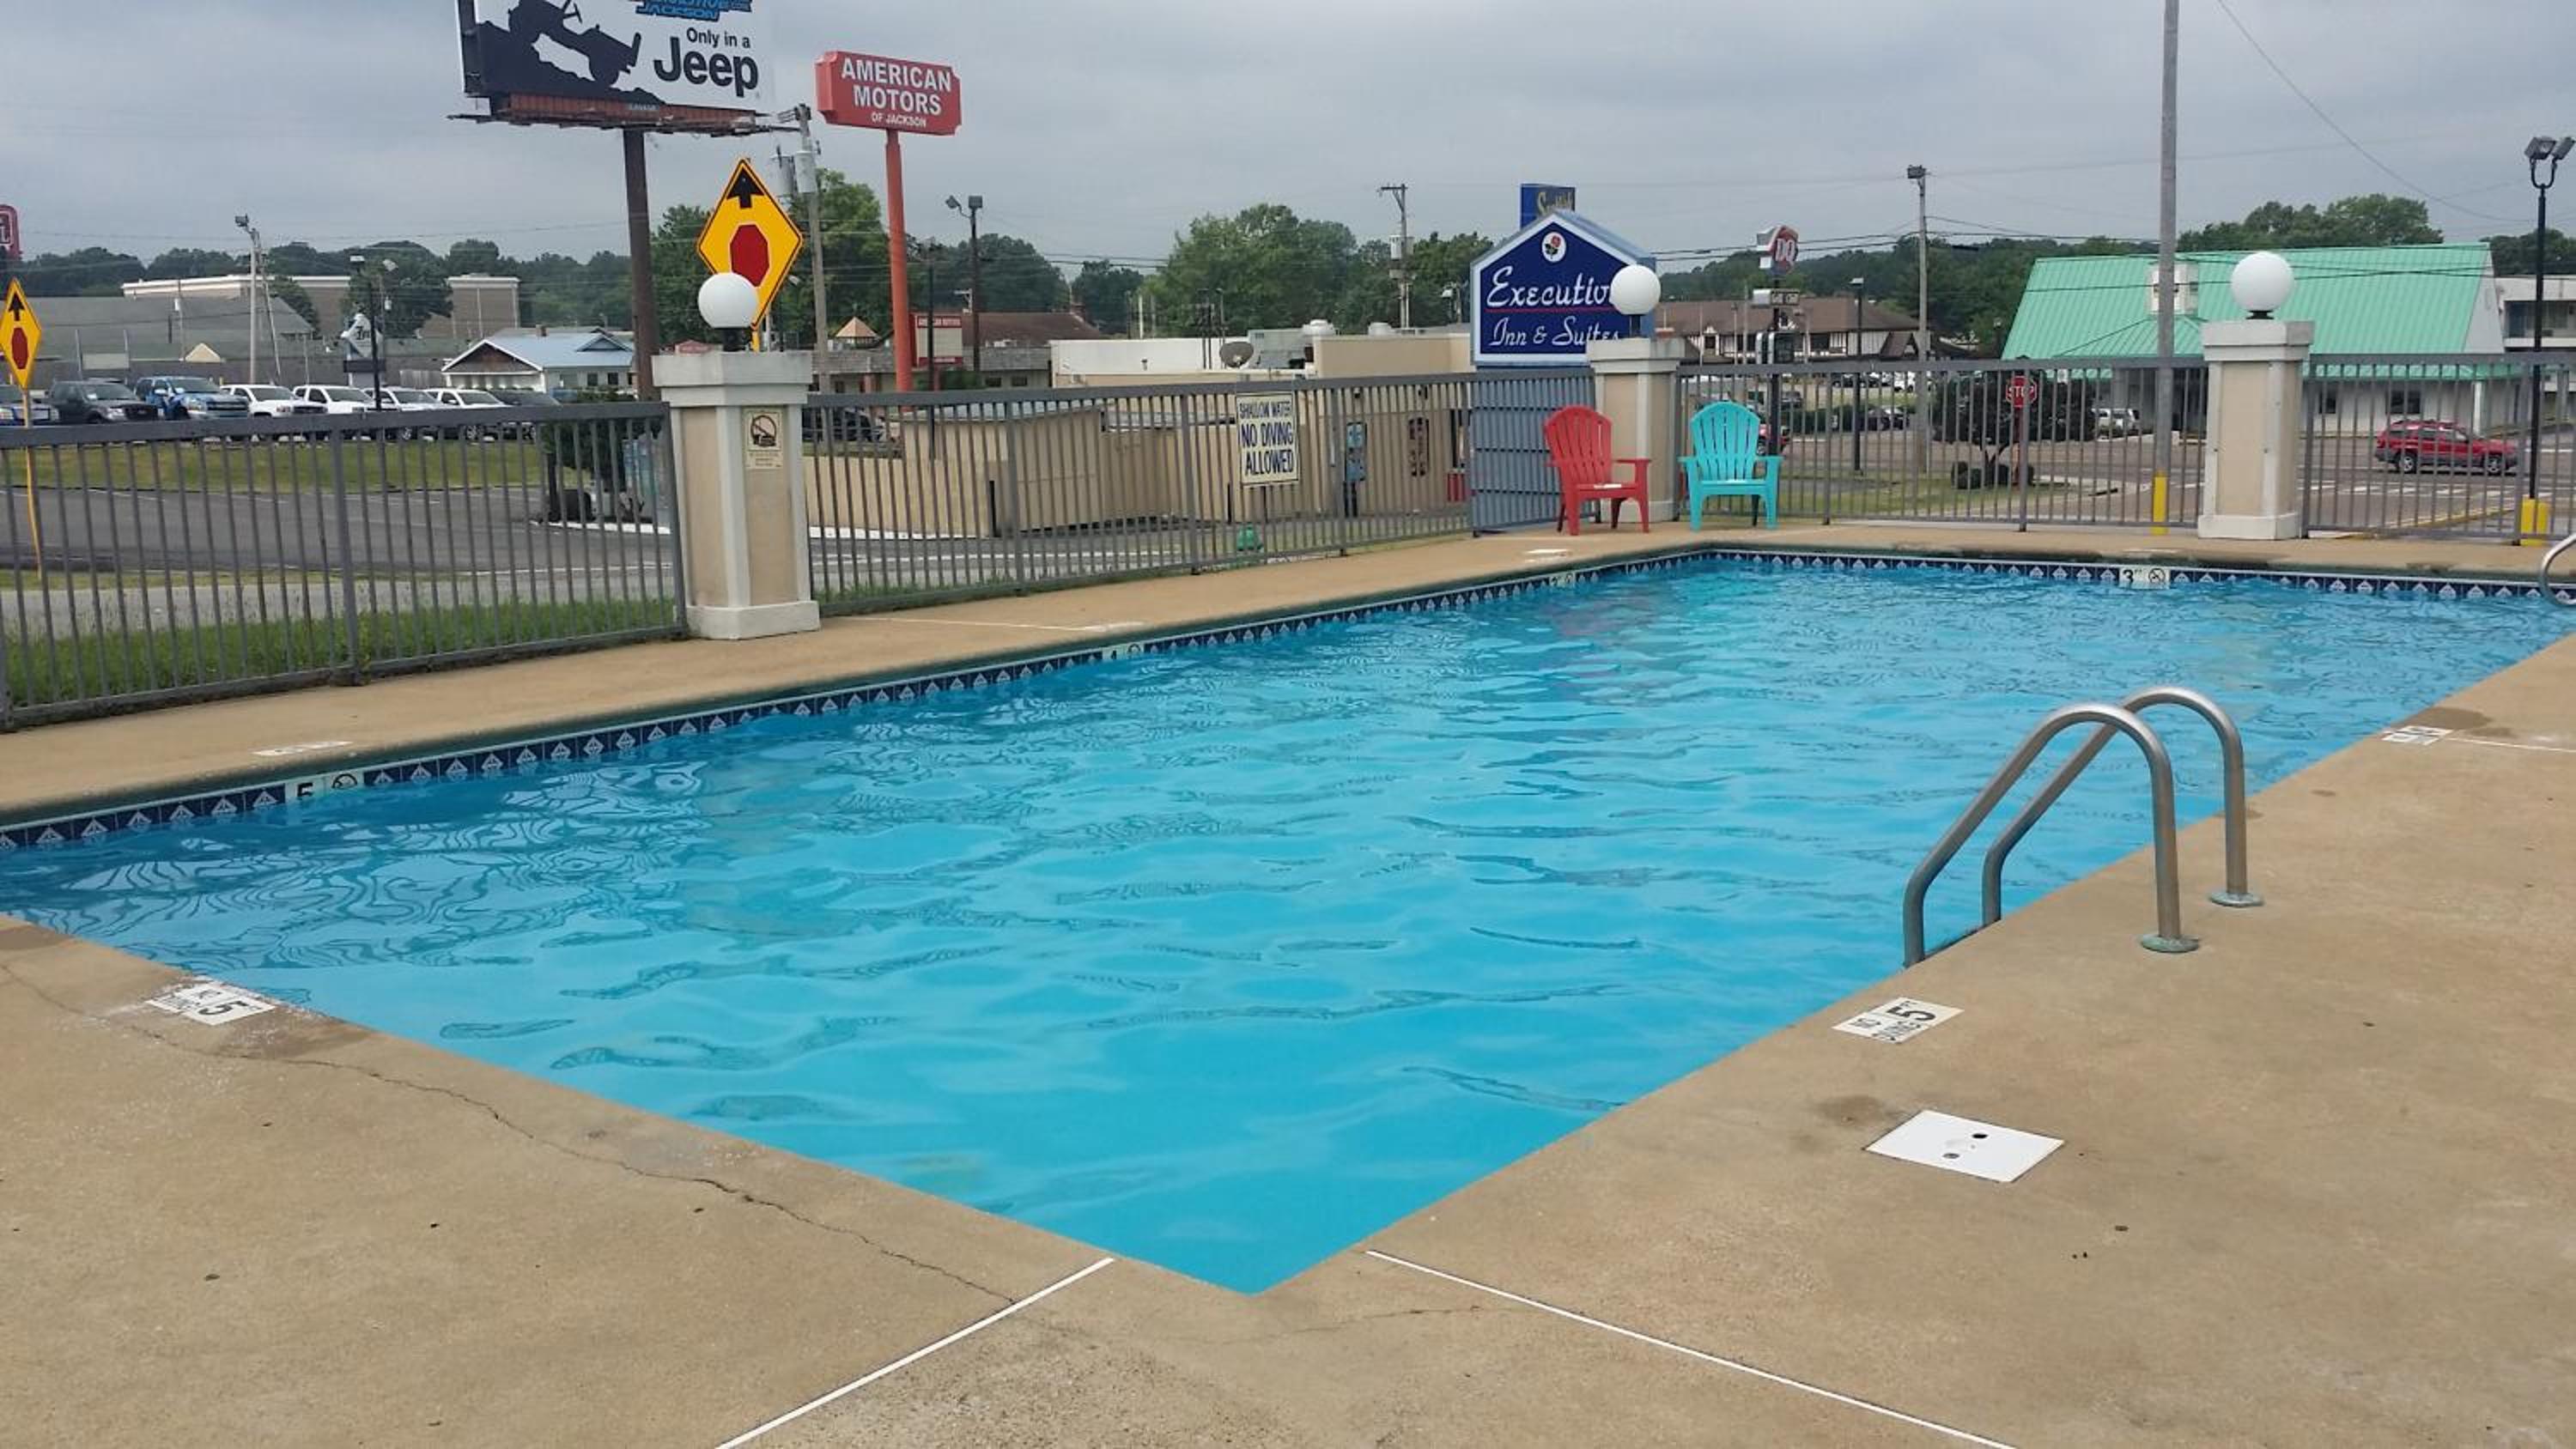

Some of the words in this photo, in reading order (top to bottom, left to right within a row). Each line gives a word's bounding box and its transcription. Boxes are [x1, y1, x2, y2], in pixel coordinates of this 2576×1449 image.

[686, 27, 720, 48] Only
[724, 31, 738, 47] in
[742, 37, 750, 48] a
[653, 36, 758, 98] Jeep
[841, 58, 951, 92] AMERICAN
[854, 85, 942, 116] MOTORS
[871, 112, 883, 122] OF
[885, 113, 927, 128] JACKSON
[1776, 238, 1795, 265] DQ
[1486, 265, 1610, 306] Executiv
[1489, 317, 1527, 346] Inn
[1533, 325, 1546, 344] &
[1241, 422, 1258, 448] NO
[1261, 421, 1294, 447] DIVING
[1244, 449, 1294, 476] ALLOWED
[198, 1000, 250, 1016] 5
[1886, 1006, 1935, 1022] 5
